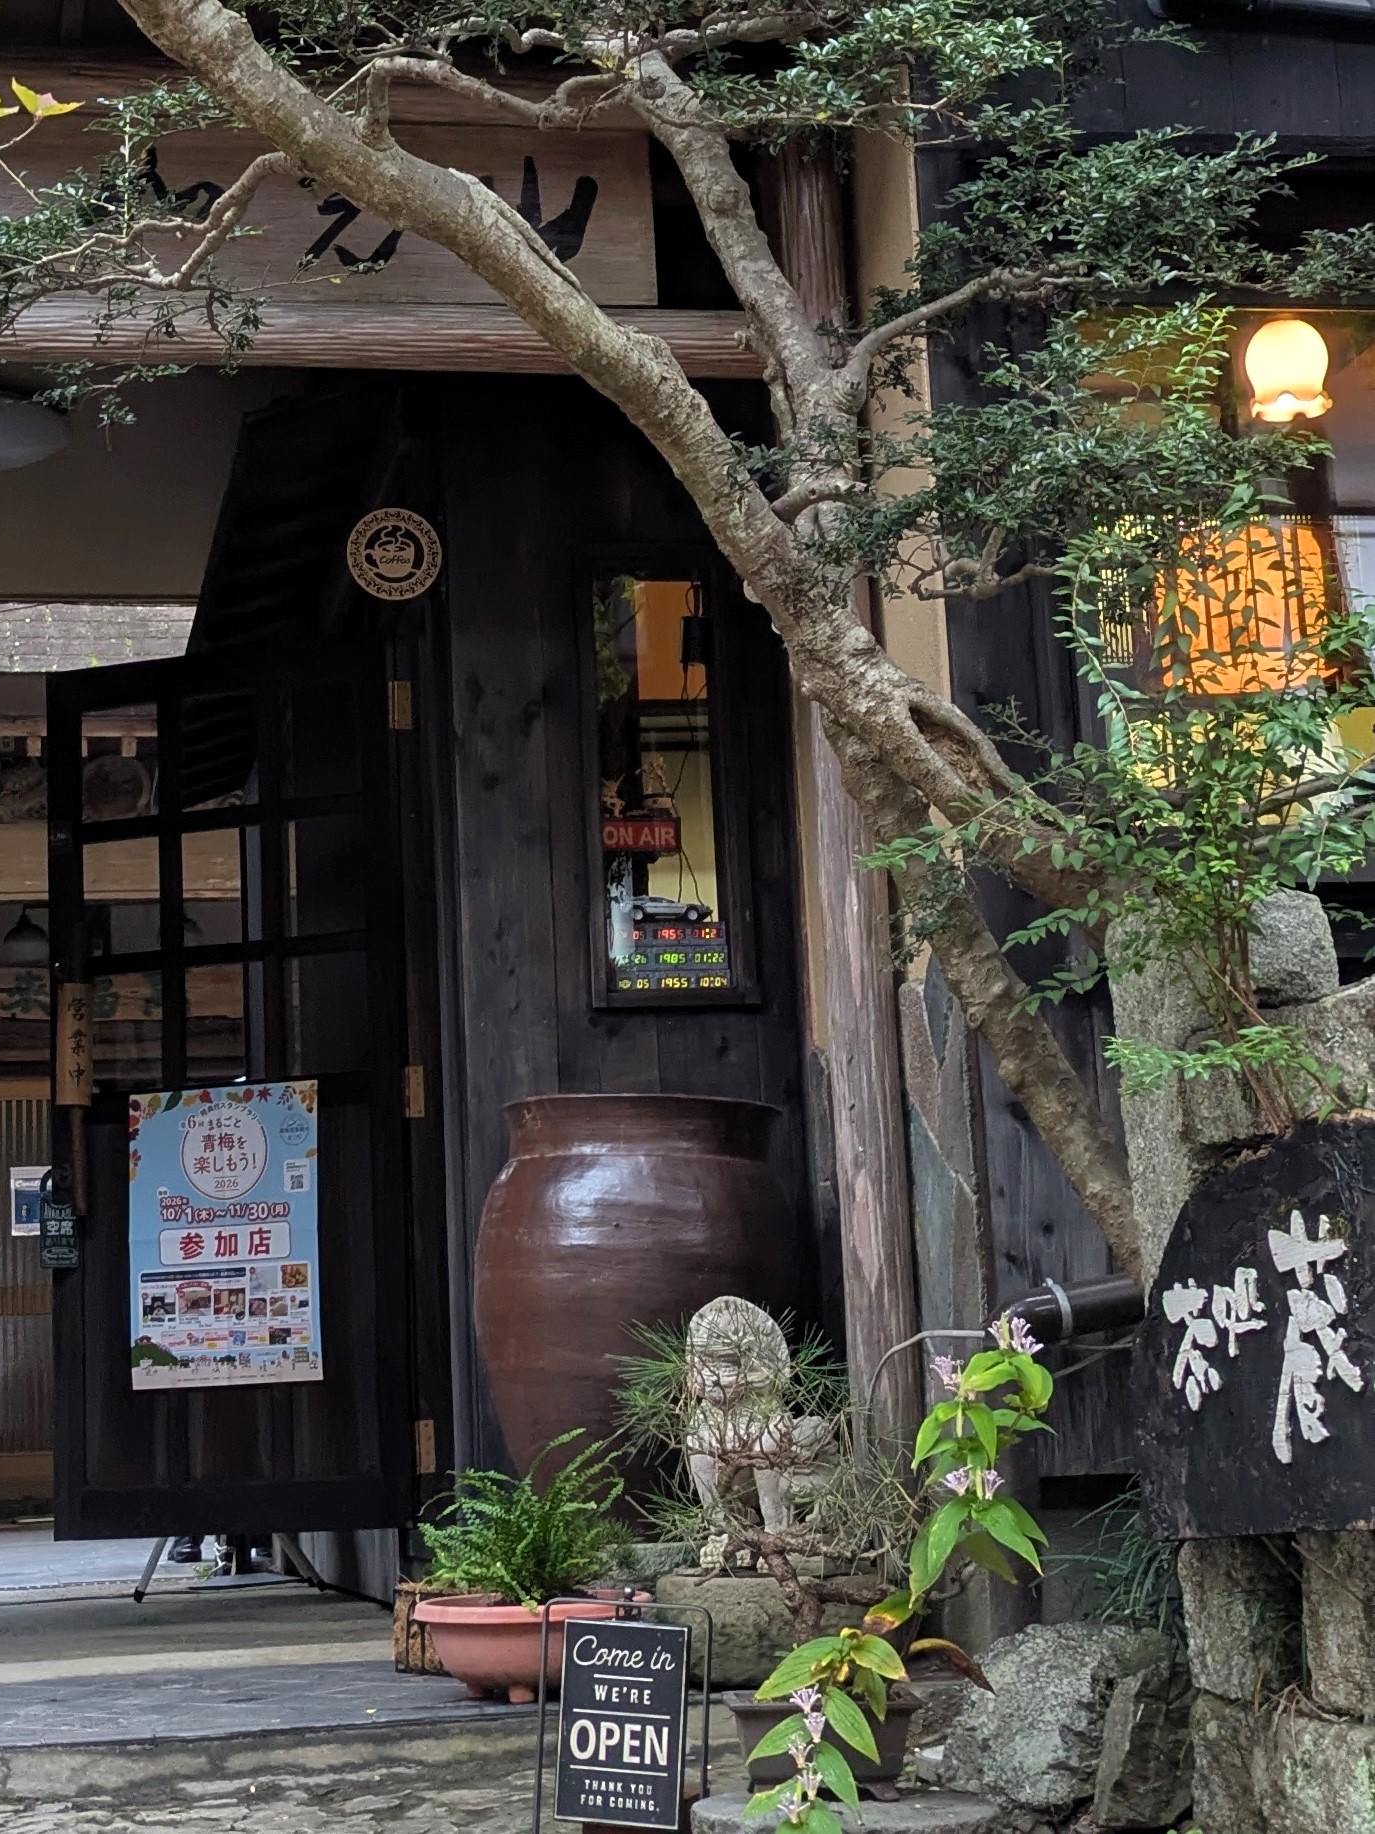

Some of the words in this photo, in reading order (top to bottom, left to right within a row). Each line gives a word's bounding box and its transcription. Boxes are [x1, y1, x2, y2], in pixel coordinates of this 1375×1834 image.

[379, 555, 411, 566] Coffee
[603, 826, 633, 846] ON
[640, 827, 676, 846] AIR
[658, 953, 686, 963] 1985
[660, 977, 688, 988] 1955
[67, 998, 87, 1087] 営業中
[201, 1132, 247, 1153] 青梅を
[46, 1220, 74, 1236] 空席
[179, 1227, 272, 1260] 参加店
[573, 1635, 645, 1669] Come
[650, 1646, 676, 1671] in
[594, 1684, 651, 1705] WE'RE
[569, 1719, 669, 1766] OPEN
[584, 1779, 623, 1793] THANK
[630, 1783, 653, 1796] YOU
[580, 1795, 603, 1807] FOR
